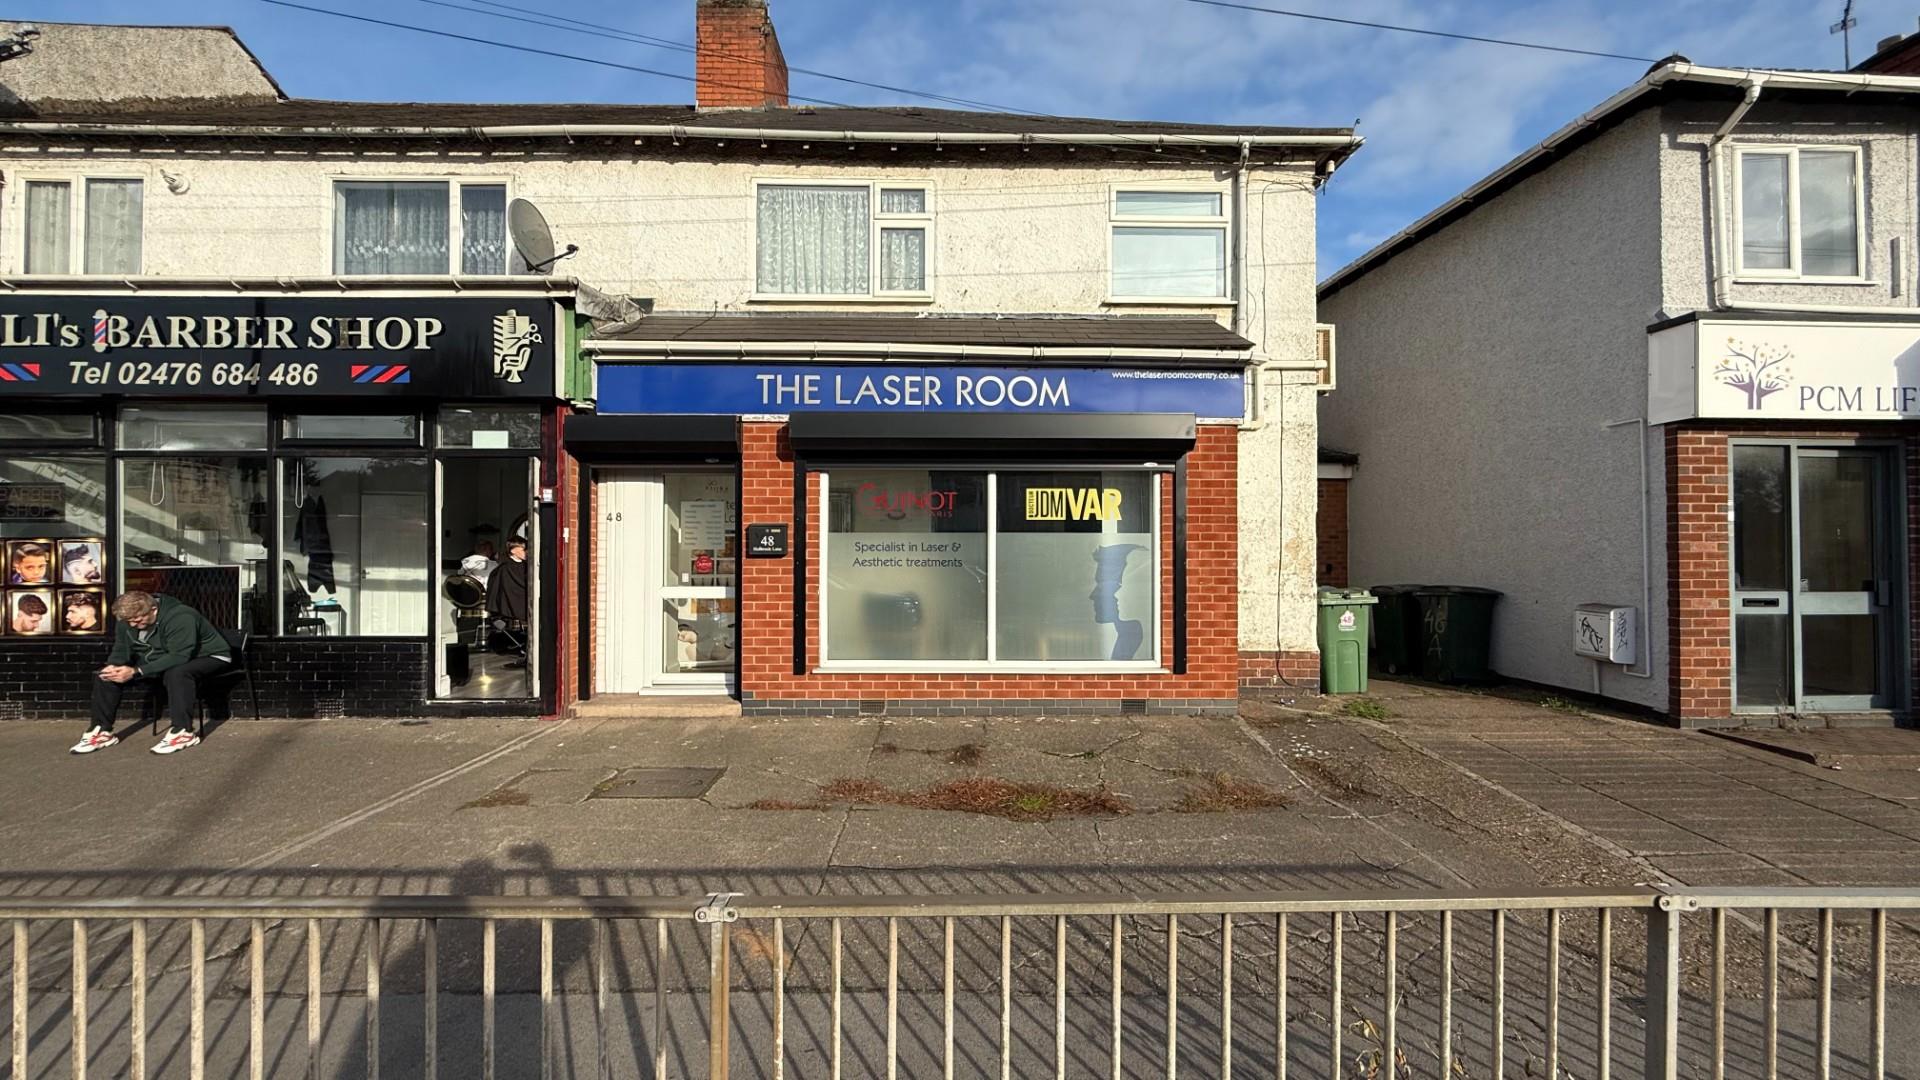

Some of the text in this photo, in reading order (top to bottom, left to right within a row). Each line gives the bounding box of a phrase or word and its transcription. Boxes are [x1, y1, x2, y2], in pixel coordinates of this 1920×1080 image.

[106, 315, 298, 349] BARBER
[307, 316, 443, 350] SHOP
[69, 361, 319, 386] Tel 02476 684 486
[1112, 370, 1240, 381] www.thelaserroomcoventry.co.uk
[756, 374, 1070, 407] THE LASER ROOM
[1799, 385, 1920, 412] PCM LIF
[760, 536, 774, 546] 48
[855, 541, 962, 554] Specialist in Laser &
[852, 557, 963, 568] Aesthetic treatments
